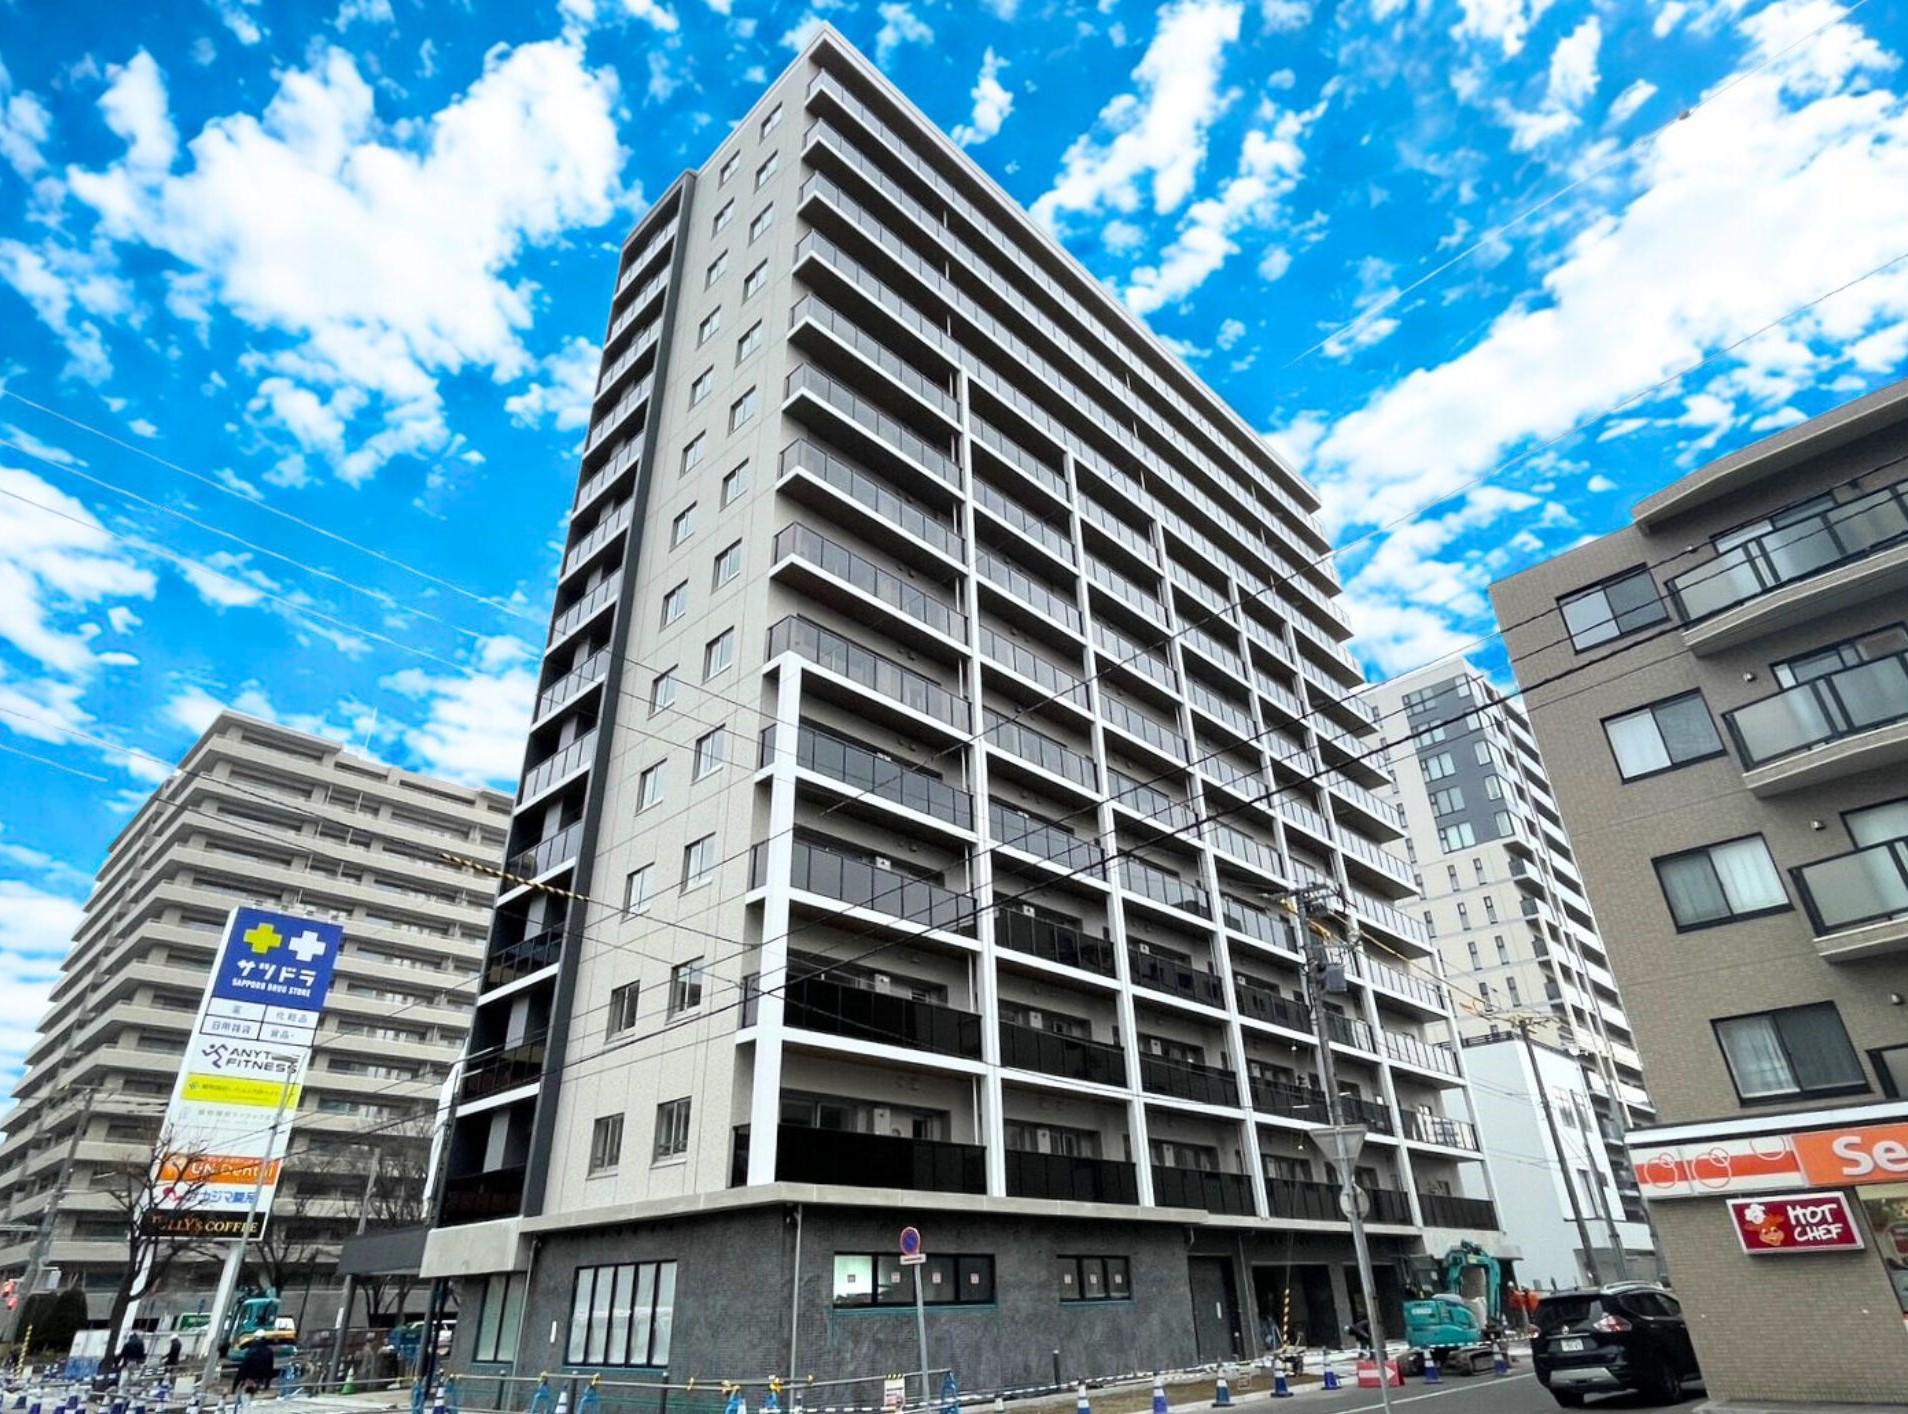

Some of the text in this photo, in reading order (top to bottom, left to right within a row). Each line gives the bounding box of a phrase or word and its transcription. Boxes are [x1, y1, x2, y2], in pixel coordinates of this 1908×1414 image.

[237, 959, 317, 987] サツドラ
[231, 978, 311, 998] SAPPORO DRUG STORE
[225, 1057, 297, 1074] FITNESS
[1832, 1136, 1908, 1173] Se
[220, 1162, 274, 1177] Dentl
[1786, 1203, 1837, 1226] HOT
[1793, 1223, 1843, 1242] CHEF
